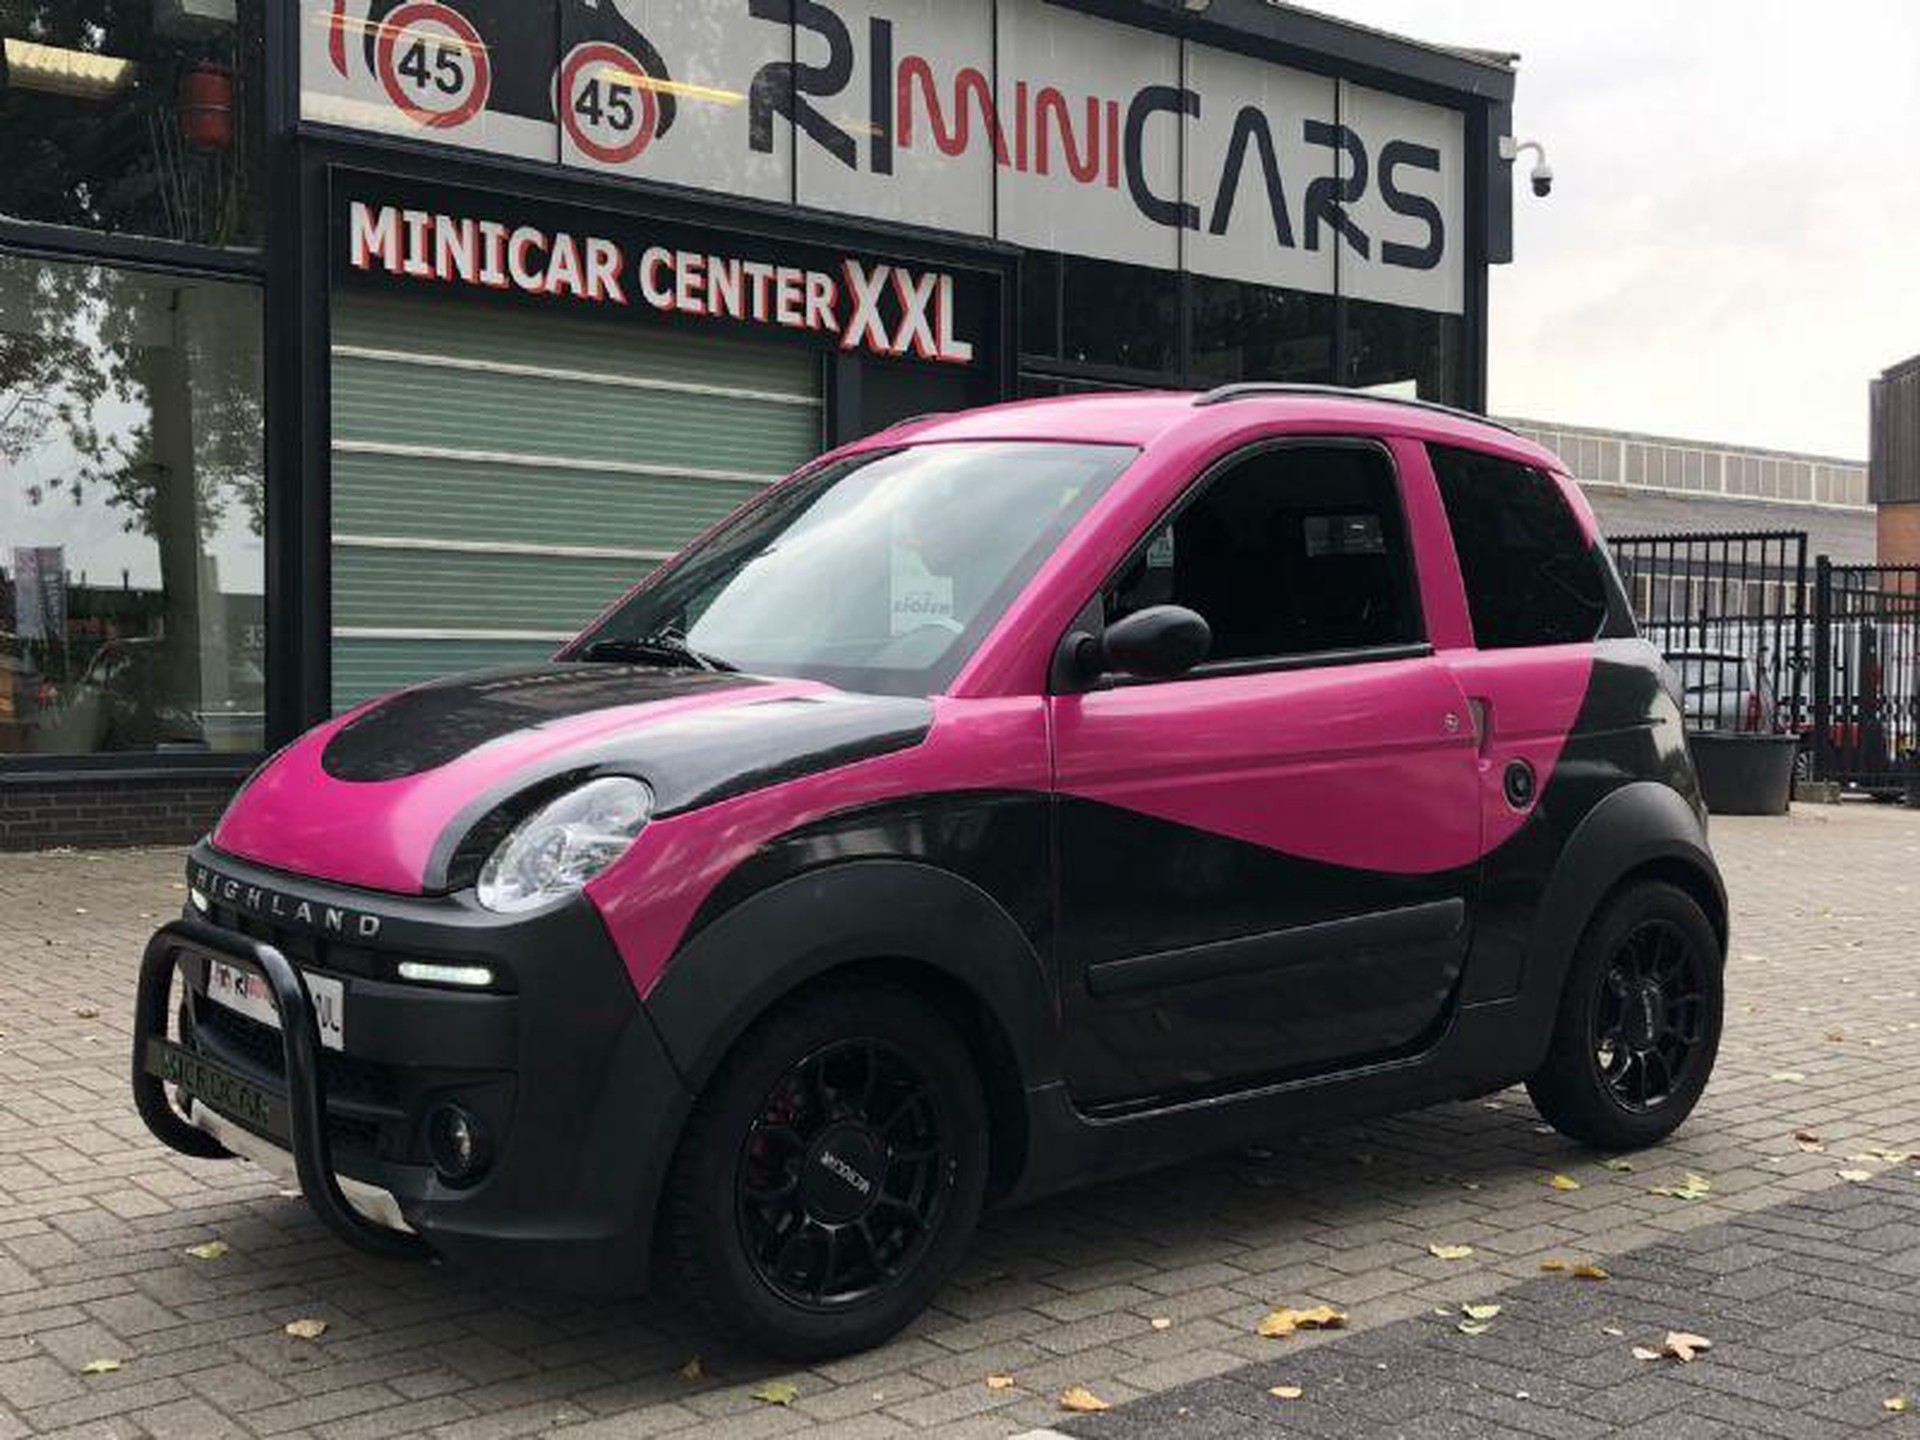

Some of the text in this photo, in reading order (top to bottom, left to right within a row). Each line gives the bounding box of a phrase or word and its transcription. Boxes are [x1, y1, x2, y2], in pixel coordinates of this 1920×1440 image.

[397, 37, 466, 95] 45
[574, 77, 635, 131] 45
[349, 201, 973, 362] MINICAR CENTER XXL
[196, 868, 381, 937] HIGHLAND
